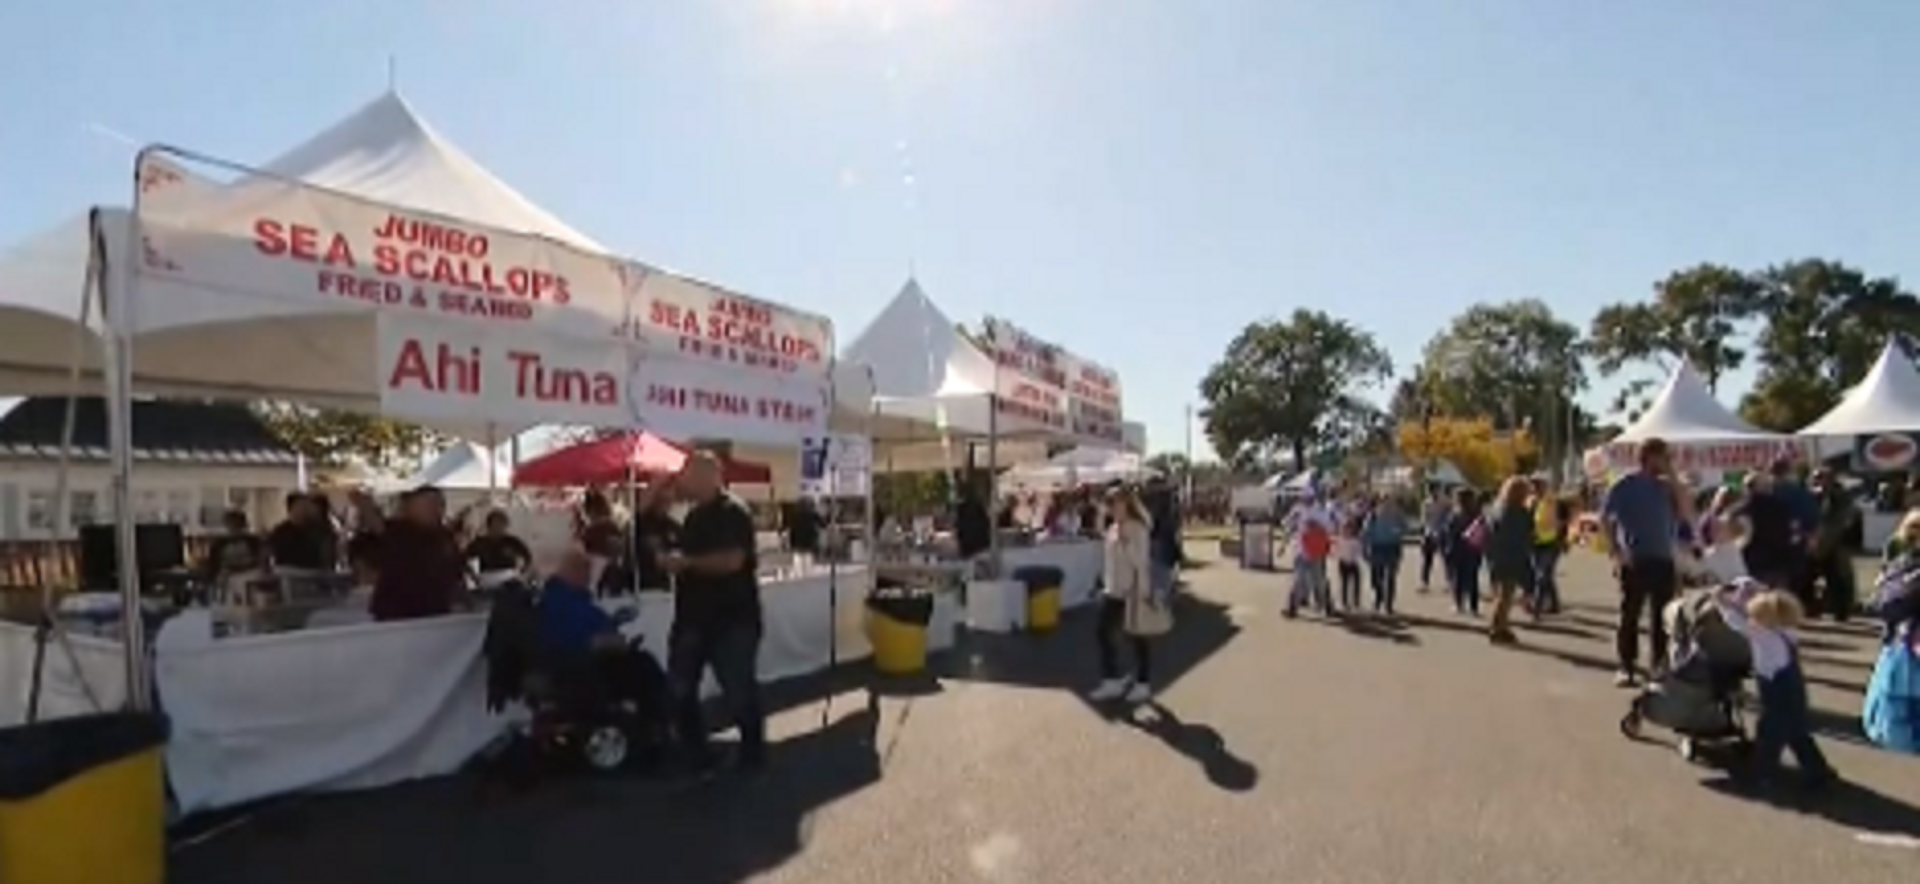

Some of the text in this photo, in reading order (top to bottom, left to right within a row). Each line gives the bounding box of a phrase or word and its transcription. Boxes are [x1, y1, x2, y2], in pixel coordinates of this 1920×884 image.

[374, 213, 488, 258] JUMBO
[253, 218, 571, 304] SEA SCALLOPS
[318, 270, 401, 303] FRIED
[651, 300, 700, 335] SEA
[389, 339, 481, 394] Ahi
[508, 351, 618, 406] Tuna
